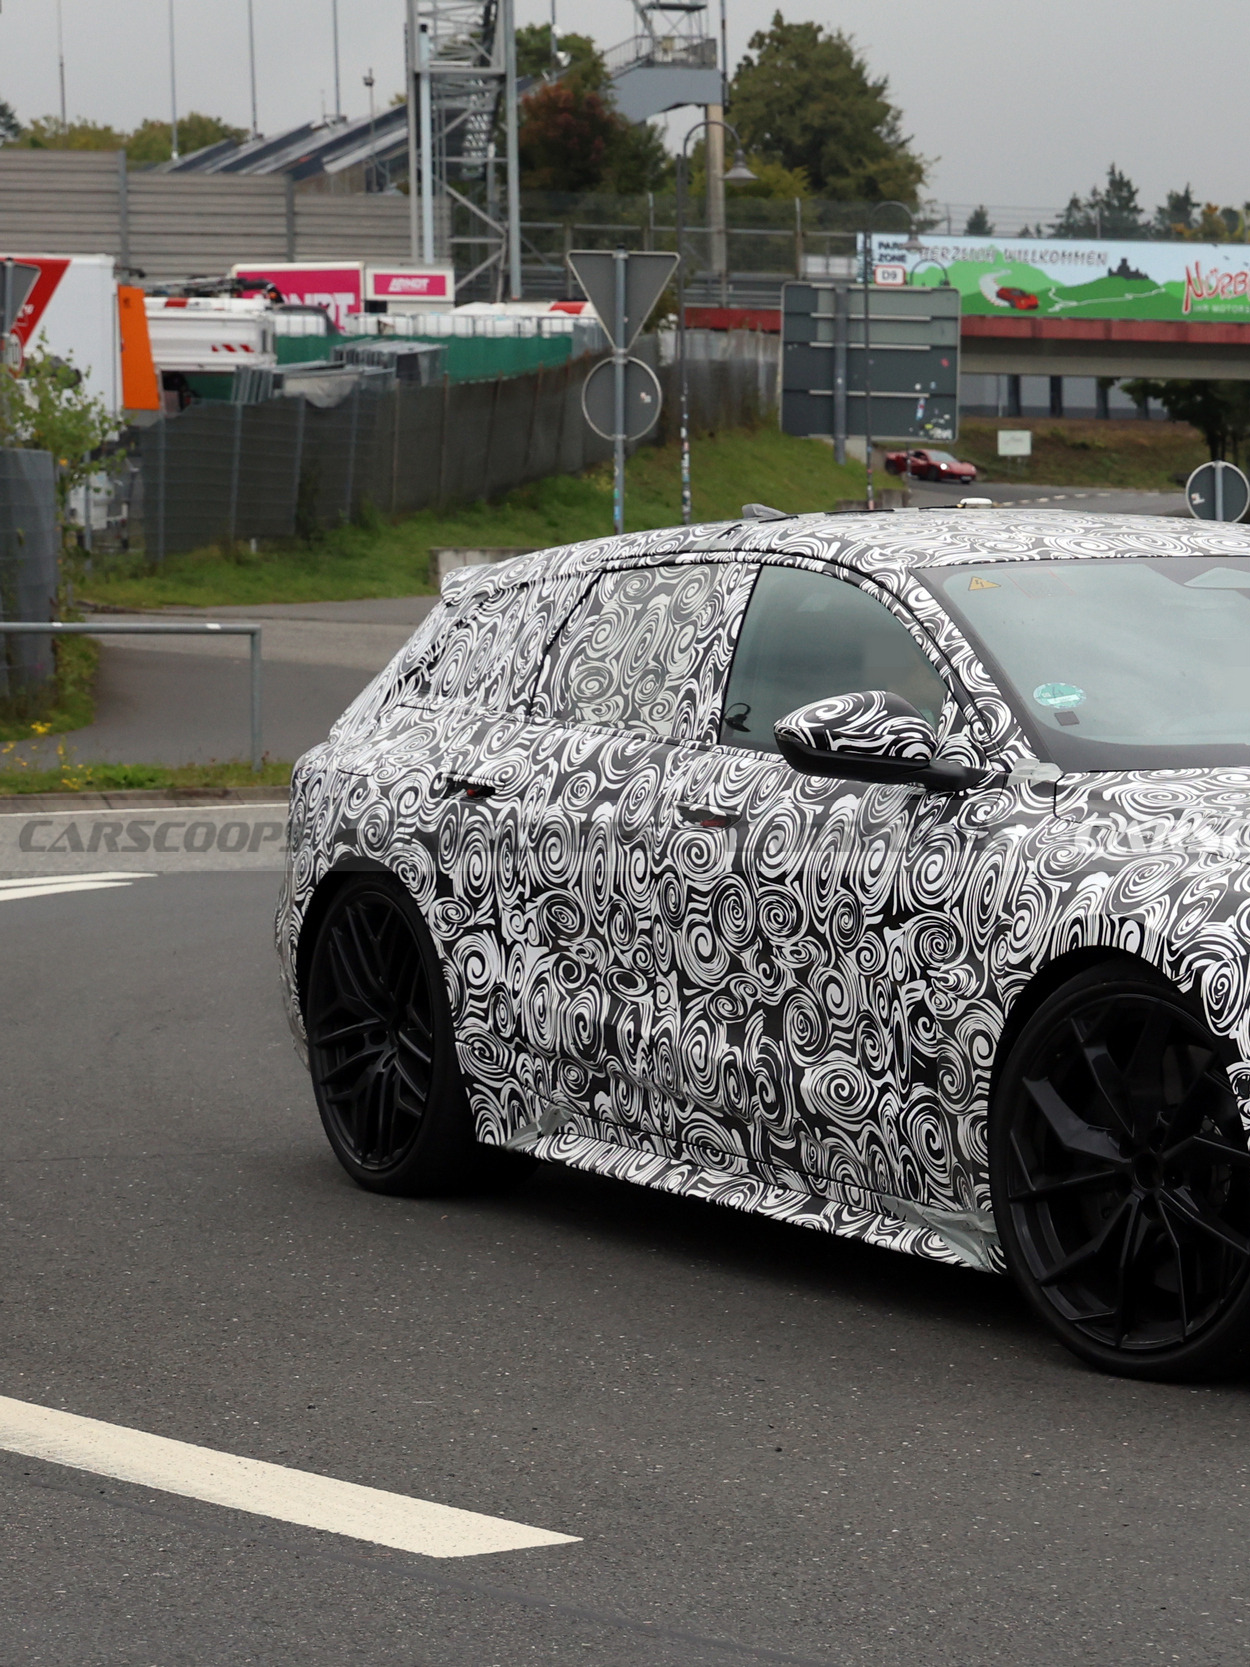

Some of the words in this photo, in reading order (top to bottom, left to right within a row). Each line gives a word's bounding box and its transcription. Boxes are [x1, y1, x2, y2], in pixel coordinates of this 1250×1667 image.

[878, 253, 906, 263] ZONE
[1004, 248, 1108, 265] WILLKOMMEN
[882, 270, 897, 281] D9
